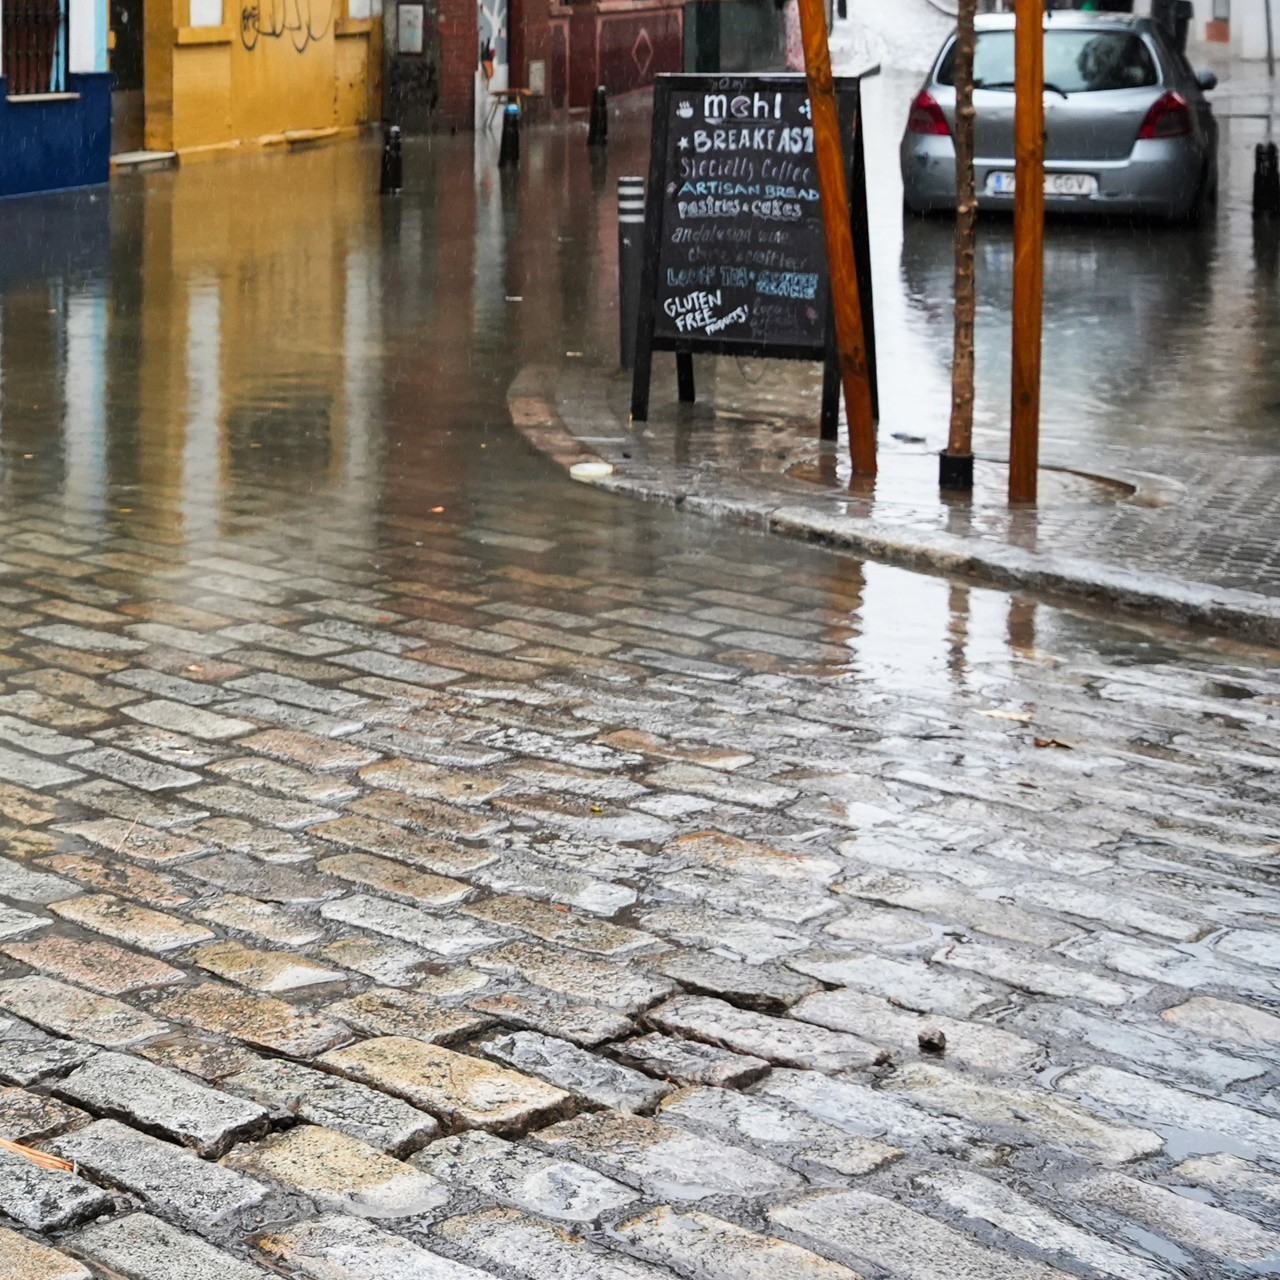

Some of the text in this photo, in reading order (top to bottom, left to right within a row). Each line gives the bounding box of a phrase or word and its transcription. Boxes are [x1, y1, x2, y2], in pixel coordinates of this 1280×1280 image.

[693, 127, 814, 153] BREAKFAST
[663, 289, 723, 318] GLUTEN
[674, 309, 718, 333] FREE
